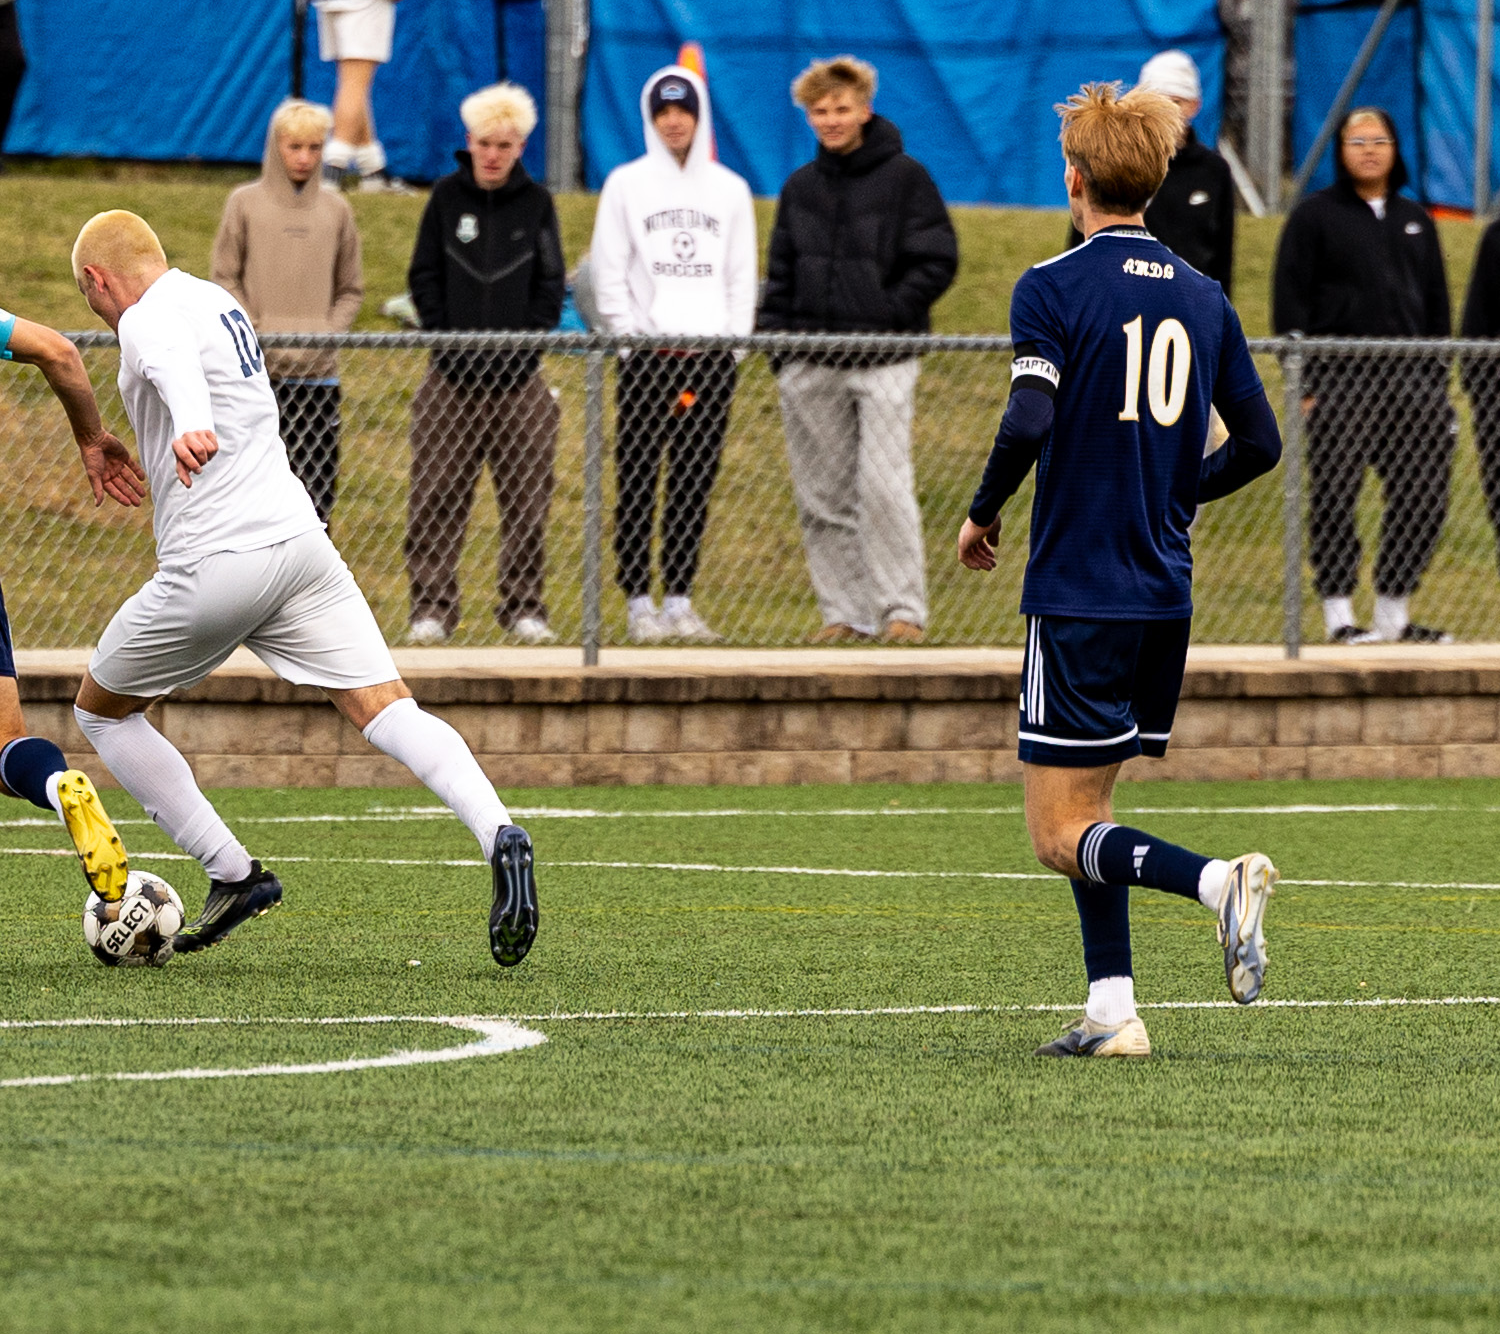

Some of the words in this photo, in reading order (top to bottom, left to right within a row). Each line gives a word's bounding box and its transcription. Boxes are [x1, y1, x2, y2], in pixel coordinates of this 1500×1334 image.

[652, 261, 713, 277] SOCCER
[1122, 257, 1175, 280] AMDG
[220, 308, 262, 379] 10
[1118, 314, 1192, 428] 10
[106, 901, 150, 954] SELECT
